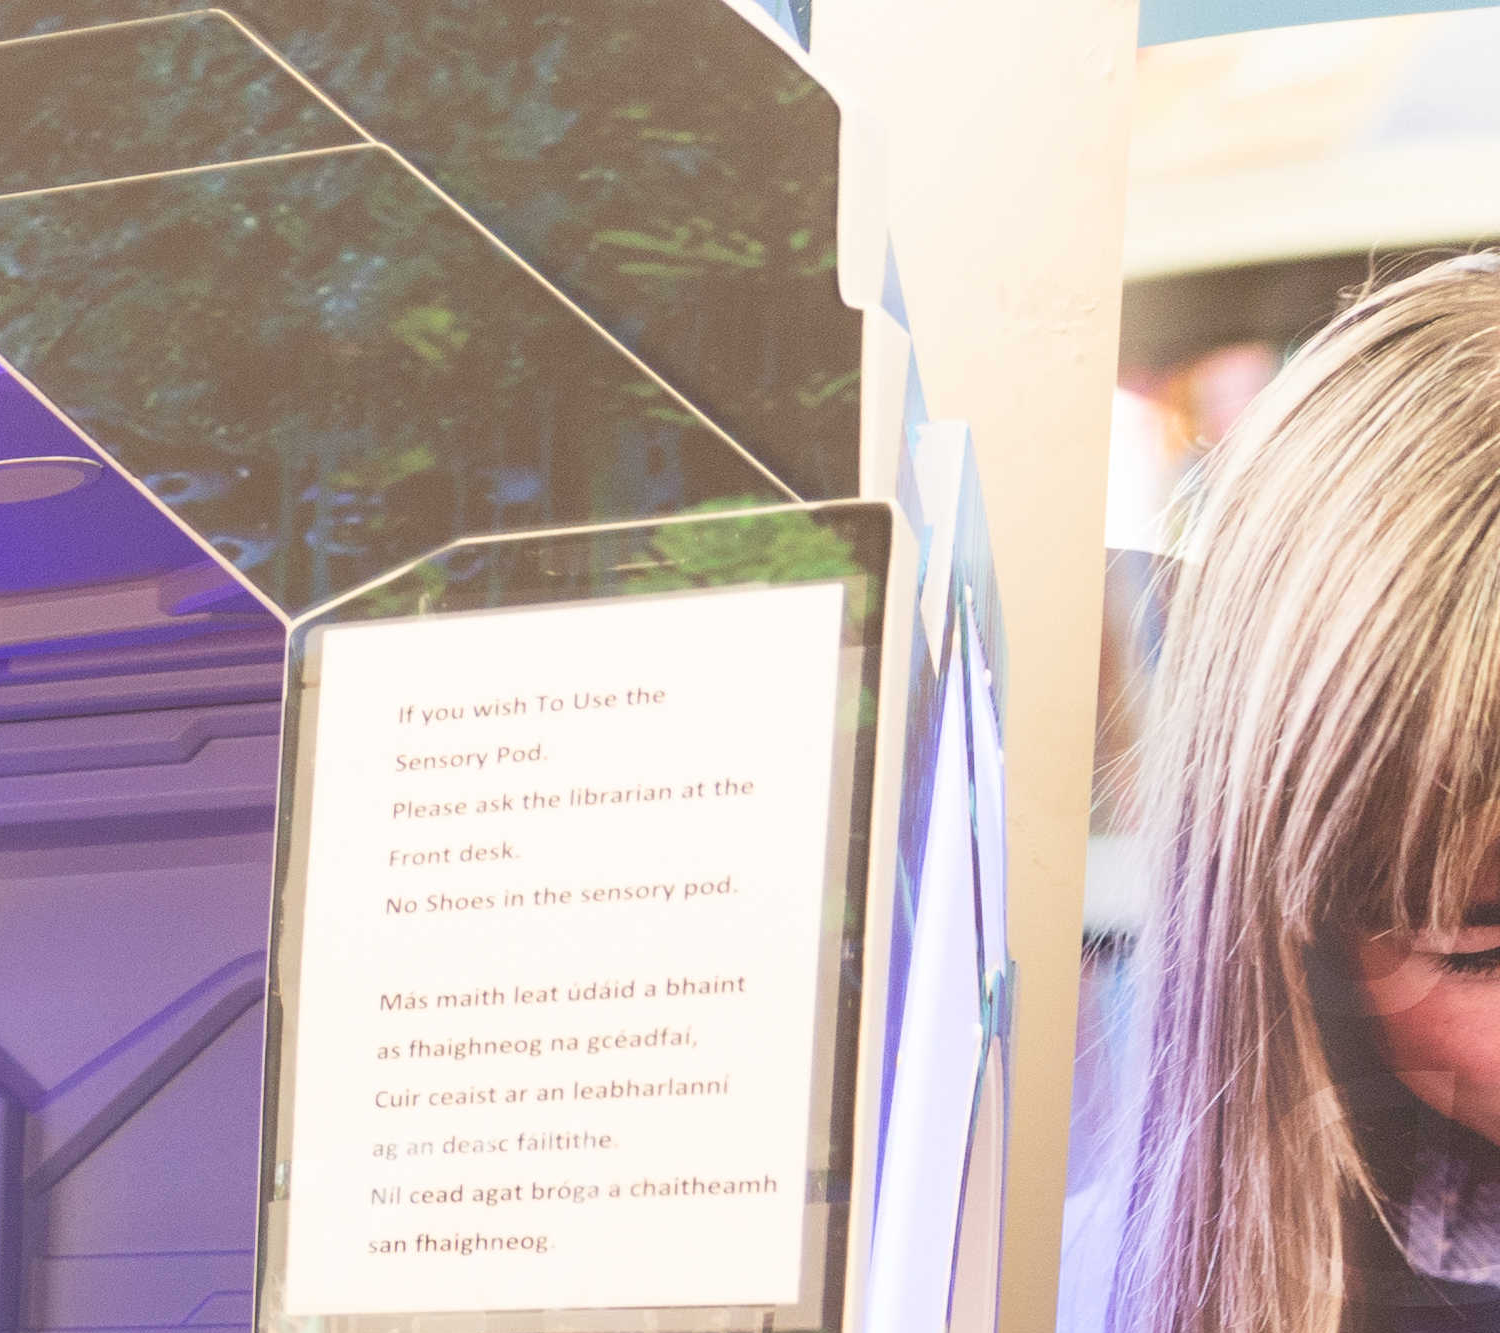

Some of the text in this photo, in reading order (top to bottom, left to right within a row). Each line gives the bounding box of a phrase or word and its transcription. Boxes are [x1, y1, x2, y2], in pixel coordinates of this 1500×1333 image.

[399, 687, 666, 727] If you wish To Use the
[395, 743, 548, 773] Sensory Pod.
[393, 777, 754, 820] Please ask the librarian at the
[389, 841, 521, 868] Front desk.
[386, 875, 738, 915] No Shoes in the sensory pod.
[379, 991, 428, 1013] Más
[436, 986, 505, 1009] maith
[513, 985, 559, 1005] leat
[643, 984, 657, 998] a
[666, 976, 746, 997] bhaint
[377, 1045, 401, 1060] as
[409, 1036, 542, 1062] fhaighneog
[550, 1037, 579, 1052] na
[375, 1089, 421, 1109] Cuir
[428, 1085, 497, 1107] ceaist
[504, 1088, 528, 1103] ar
[536, 1085, 565, 1101] an
[372, 1142, 398, 1162] ag
[406, 1140, 434, 1156] an
[442, 1135, 509, 1155] deasc
[409, 1184, 463, 1205] cead
[471, 1183, 524, 1206] agat
[532, 1180, 600, 1204] bróga
[608, 1184, 621, 1198] a
[629, 1174, 778, 1198] chaitheamh
[368, 1233, 556, 1257] san fhaighneog.
